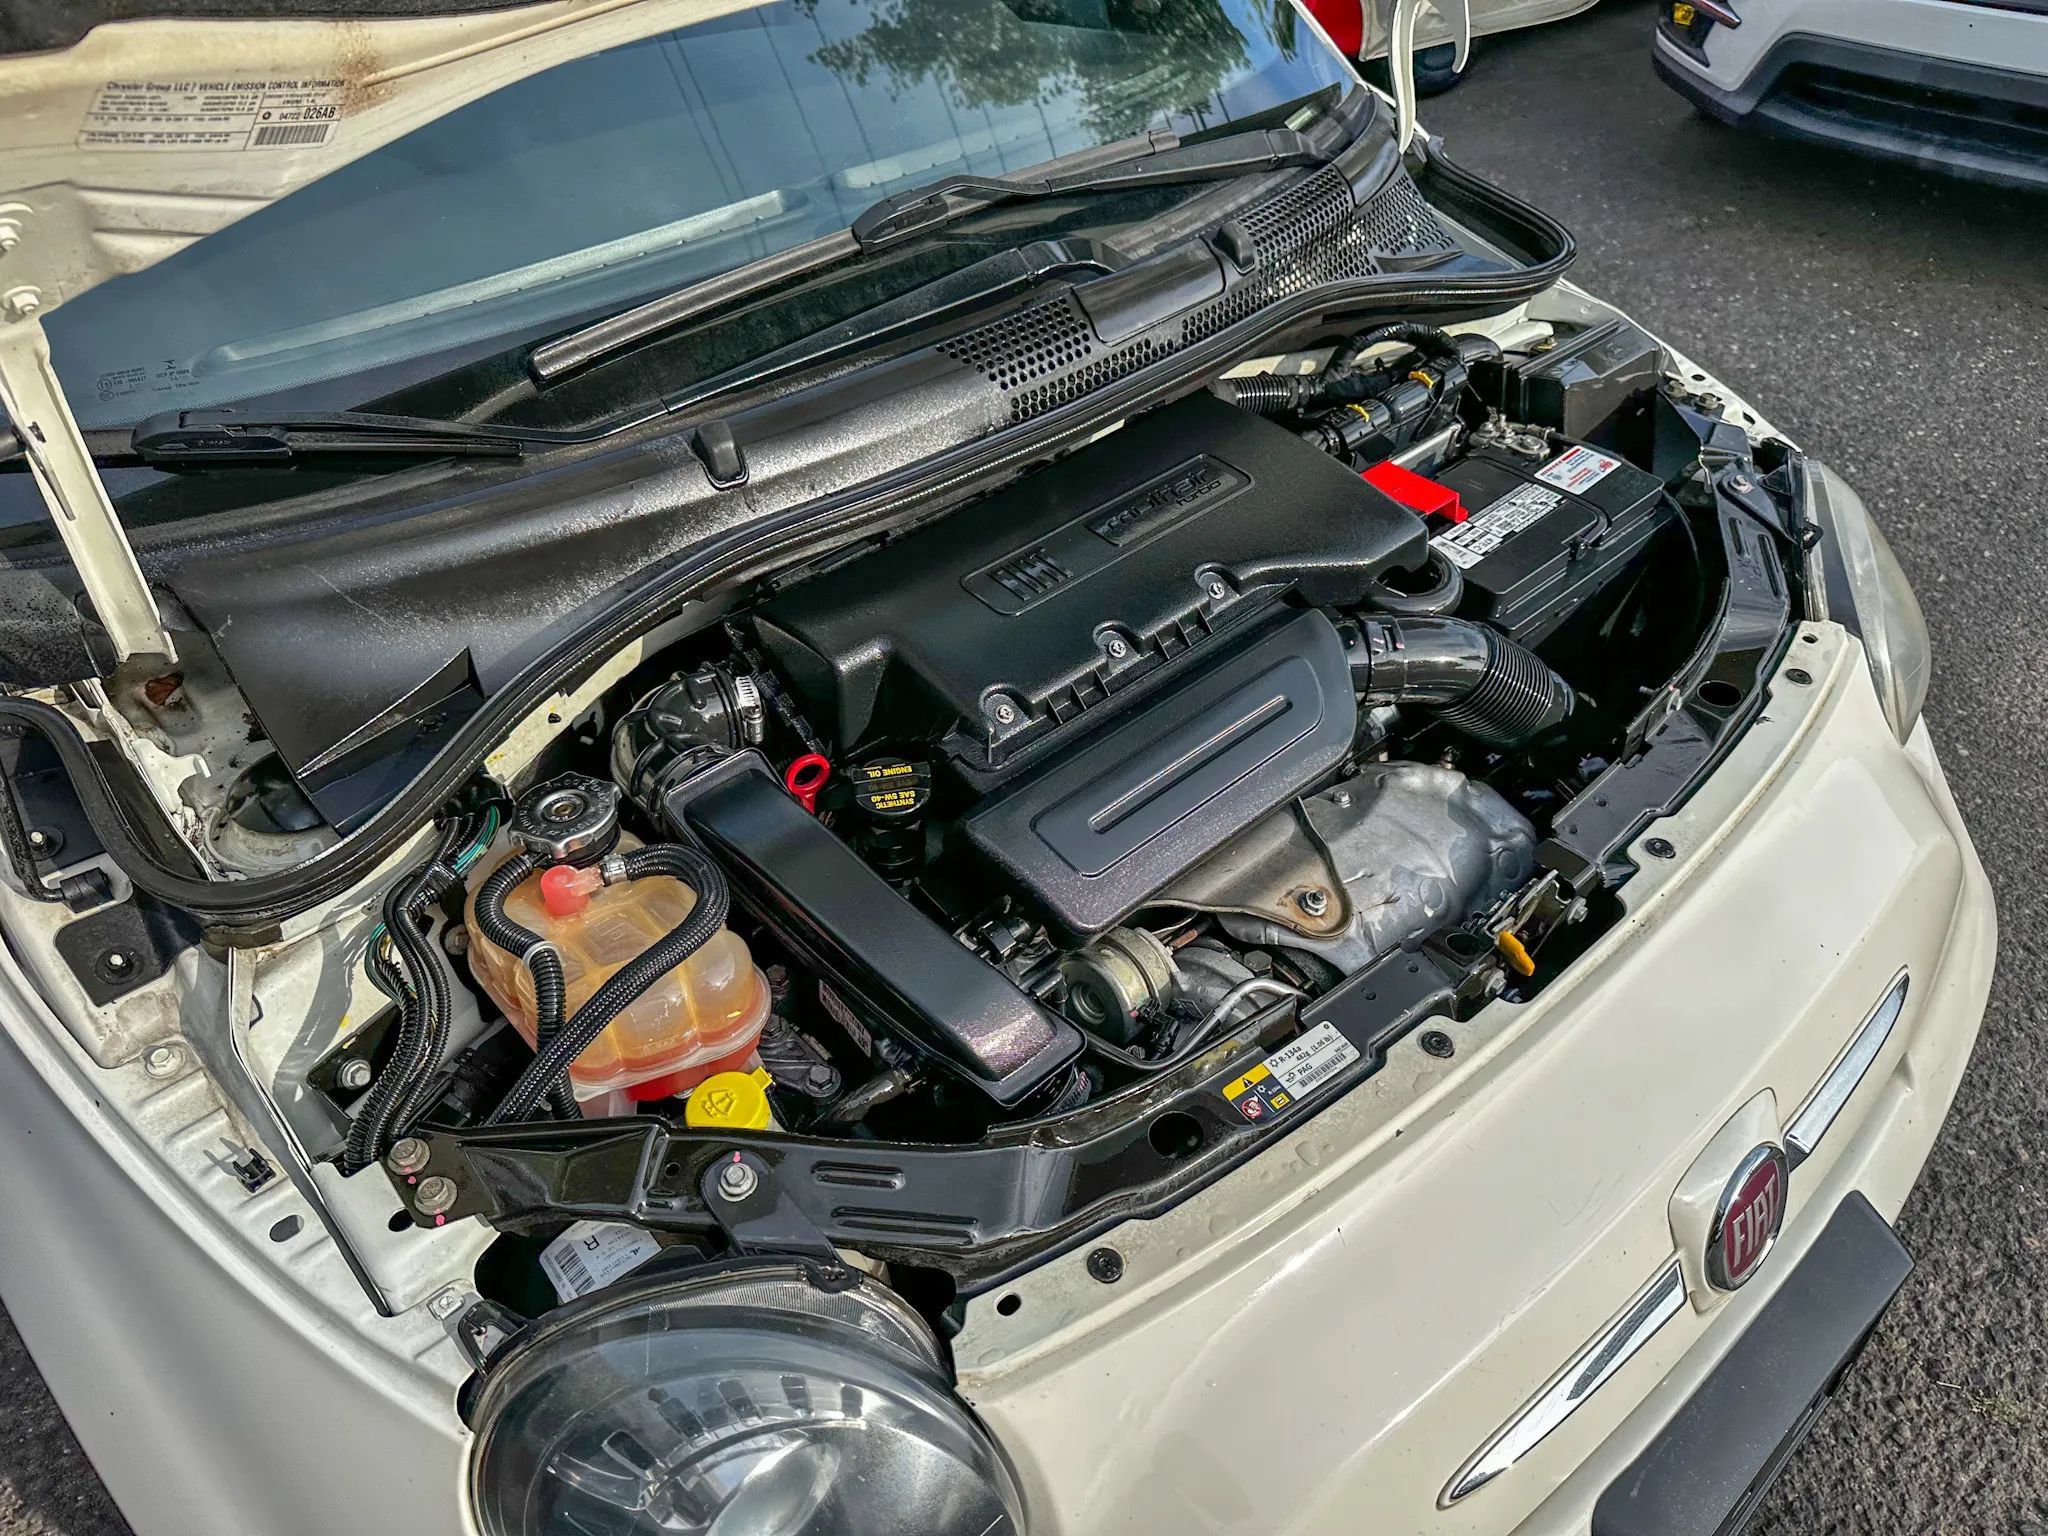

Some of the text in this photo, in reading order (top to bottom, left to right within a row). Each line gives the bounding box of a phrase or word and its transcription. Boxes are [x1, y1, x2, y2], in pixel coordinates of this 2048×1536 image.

[145, 81, 172, 91] Group
[174, 82, 191, 91] LLC
[199, 81, 229, 91] VEHICLE
[232, 81, 266, 90] EMISSION
[268, 80, 298, 90] CONTROL
[301, 80, 344, 89] INFORMATION
[303, 107, 336, 120] 026AB
[1176, 480, 1221, 506] turbo
[987, 547, 1073, 601] FIAT
[867, 765, 913, 778] ENGINE OIL
[871, 790, 916, 803] SAE 5W-40
[875, 798, 915, 809] SYNTHETIC
[1279, 1045, 1303, 1063] R-134a
[1295, 1034, 1334, 1062] 482g (1.06 lb)
[1297, 1063, 1313, 1076] PAG
[1732, 1174, 1776, 1268] FIAT
[583, 1235, 600, 1251] R
